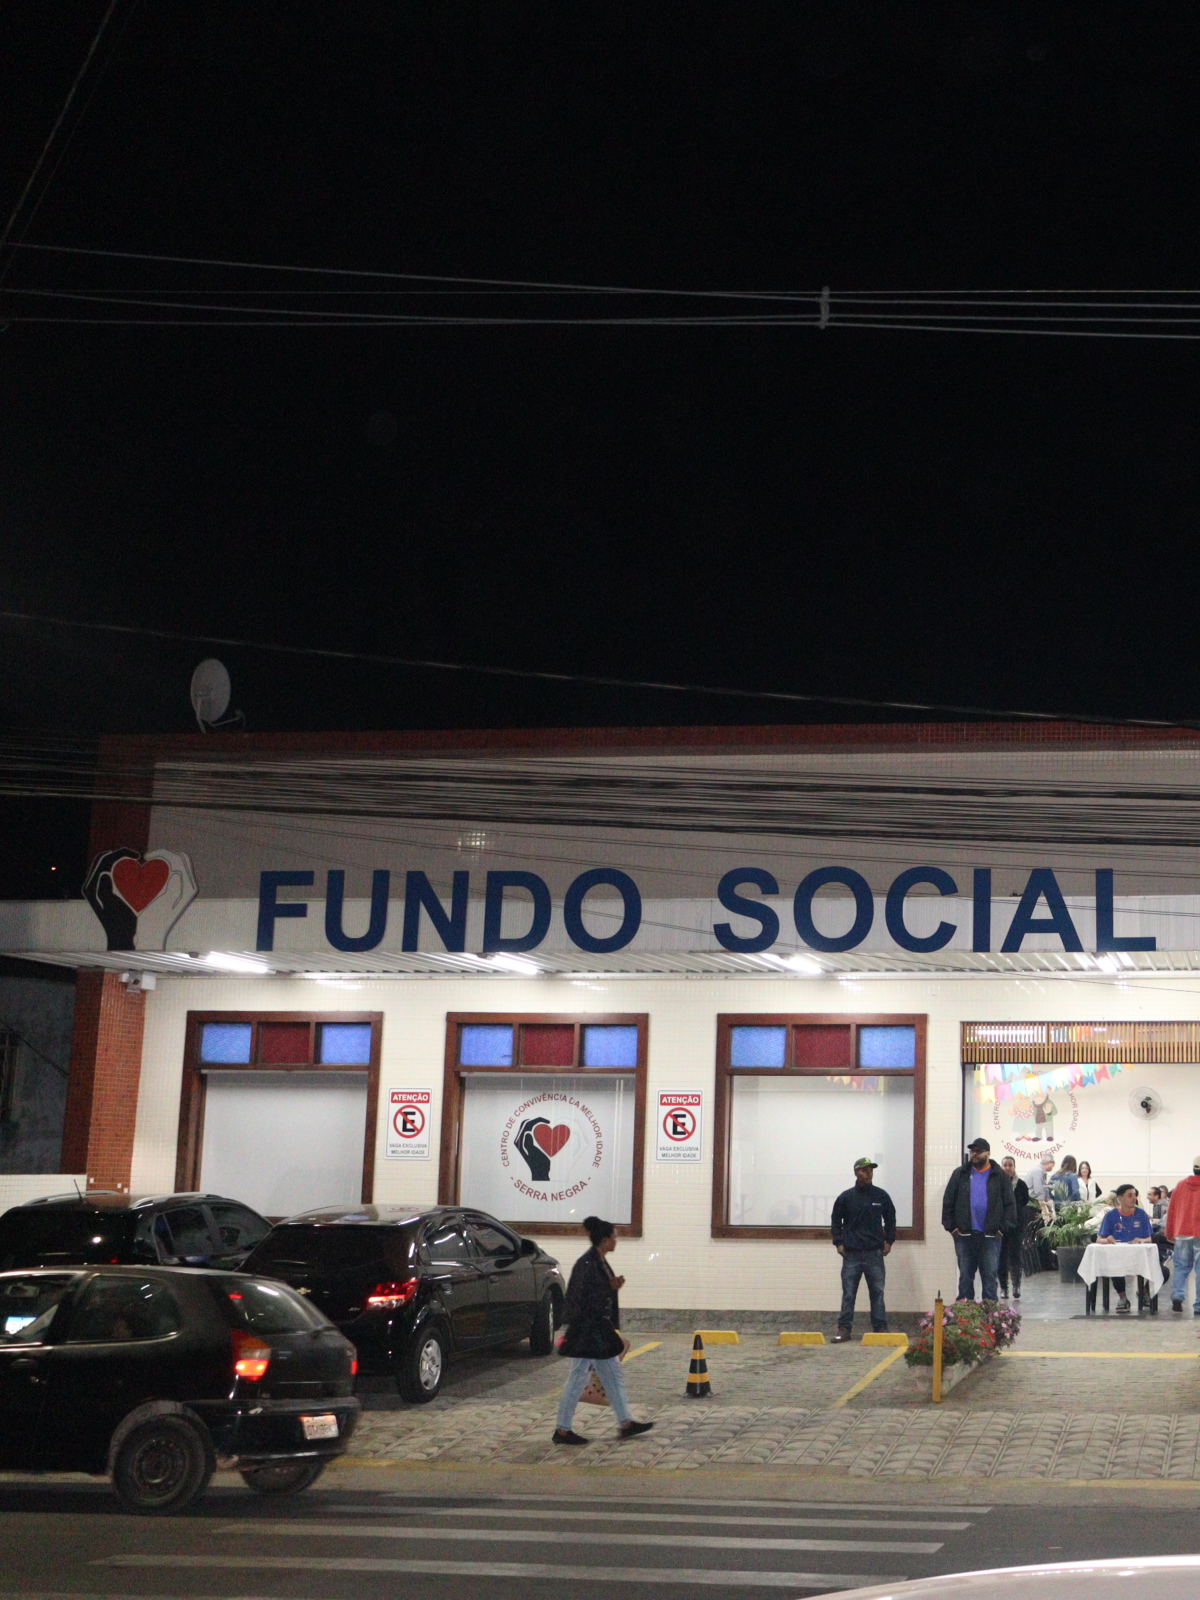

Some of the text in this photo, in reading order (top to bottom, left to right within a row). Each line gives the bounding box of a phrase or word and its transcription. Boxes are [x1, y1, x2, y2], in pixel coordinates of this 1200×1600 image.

[256, 868, 642, 953] FUNDO
[713, 865, 1157, 953] SOCIAL
[392, 1093, 429, 1102] ATENÇÃO
[661, 1095, 699, 1105] ATENÇÃO
[993, 1101, 1001, 1131] CENTRO
[1069, 1109, 1079, 1132] IDADE
[500, 1130, 510, 1167] CENTRO
[506, 1117, 516, 1130] DE
[514, 1092, 568, 1116] CONVIVÊNCIA
[580, 1104, 602, 1139] MELHOR
[592, 1140, 604, 1169] IDADE
[1004, 1142, 1032, 1160] SERRA
[513, 1179, 589, 1202] SERRA NEGRA
